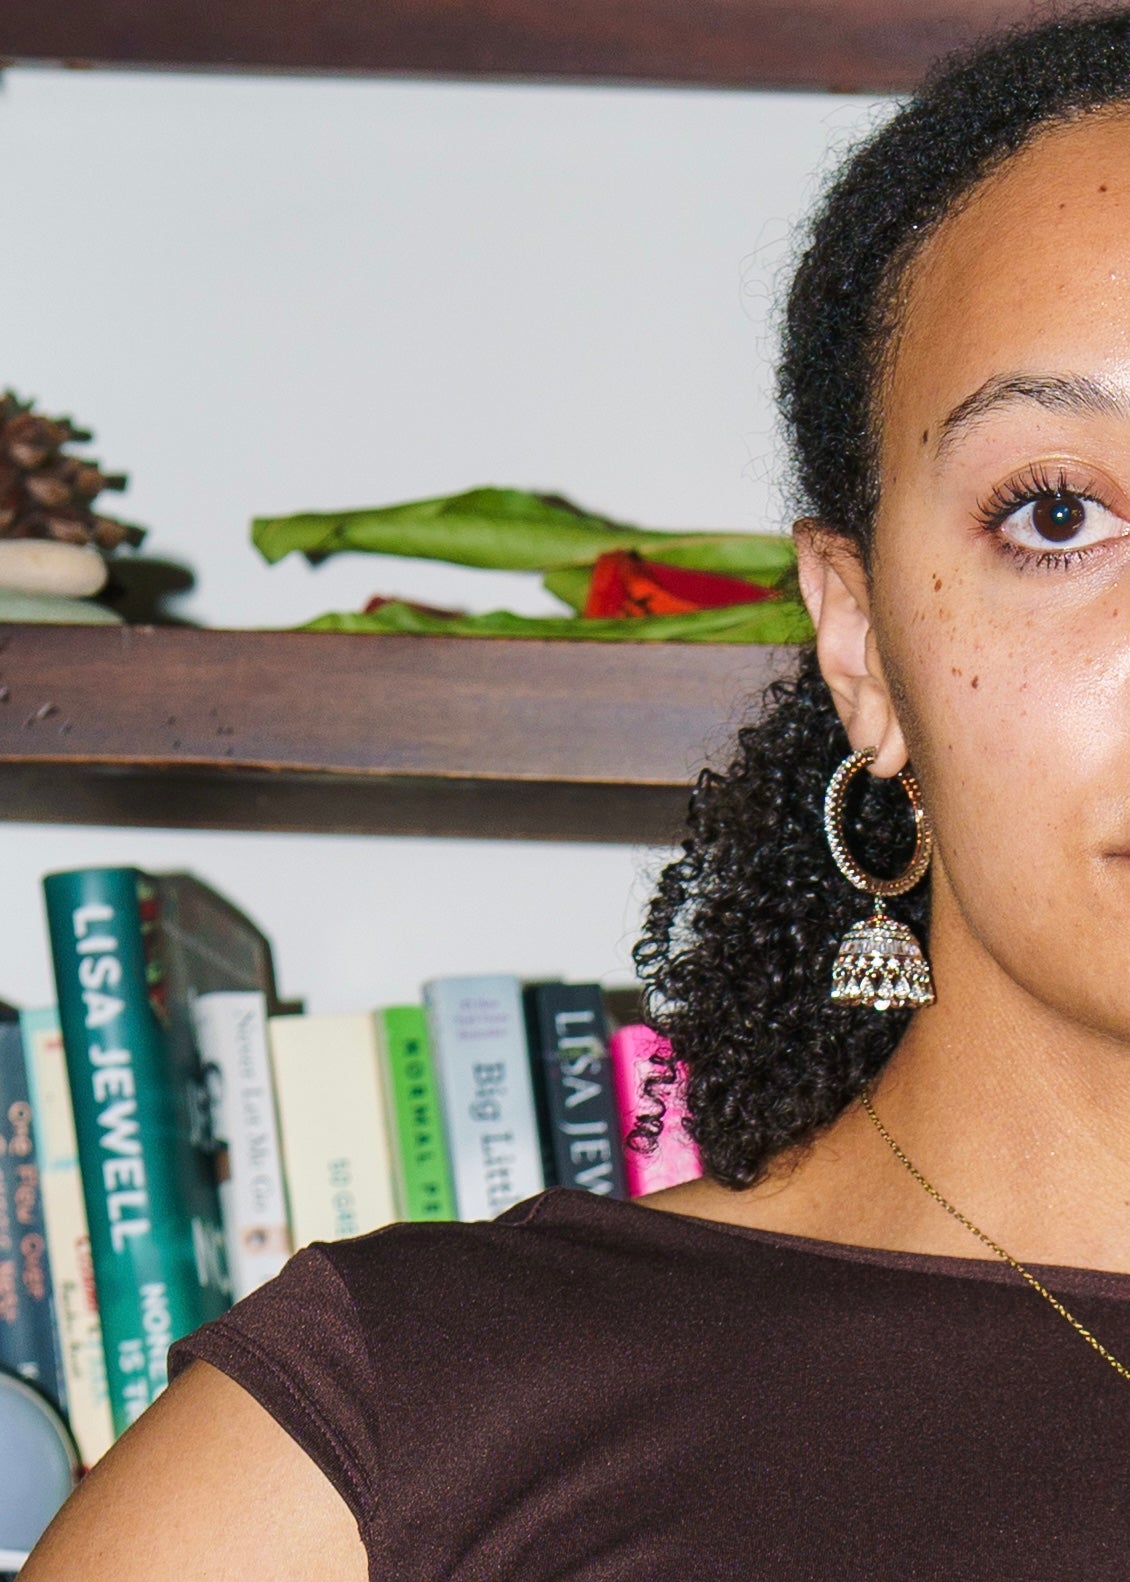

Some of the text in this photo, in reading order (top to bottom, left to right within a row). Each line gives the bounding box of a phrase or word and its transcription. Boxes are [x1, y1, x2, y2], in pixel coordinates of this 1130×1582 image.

[73, 904, 150, 1255] LISA JEWELL
[405, 1037, 432, 1165] NORMAL
[468, 1062, 507, 1122] Big
[555, 1010, 603, 1109] LISA
[481, 1132, 521, 1211] Littl
[117, 1338, 146, 1375] IS
